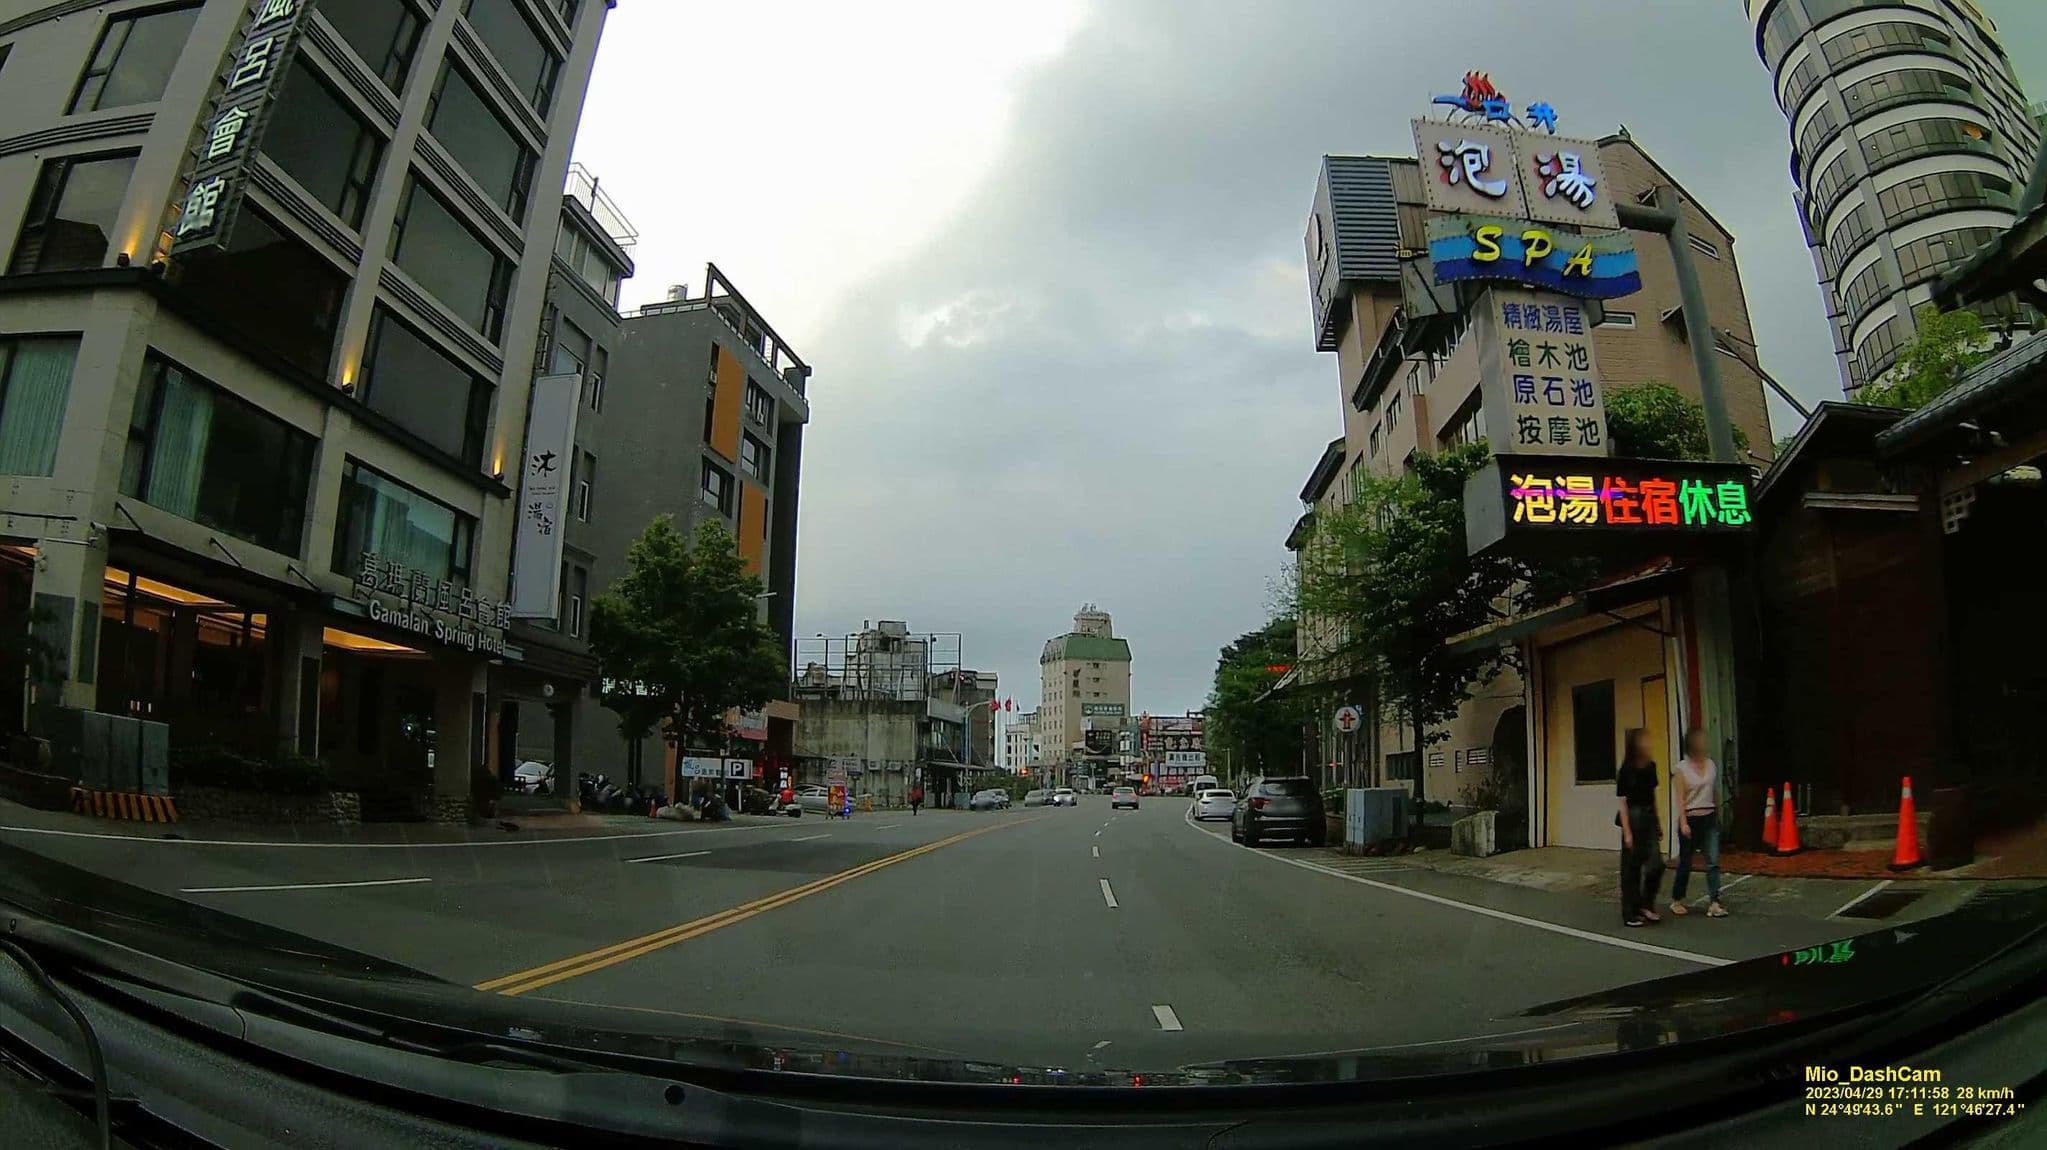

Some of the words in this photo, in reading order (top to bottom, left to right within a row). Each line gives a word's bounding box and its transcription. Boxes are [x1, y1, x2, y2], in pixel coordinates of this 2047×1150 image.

[1437, 138, 1596, 209] 泡湯
[1472, 224, 1594, 277] SPA
[1507, 338, 1590, 371] 檜木池
[1513, 375, 1595, 408] 原石池
[1517, 414, 1601, 447] 按摩池
[1509, 474, 1751, 526] 泡湯住宿休息
[369, 599, 429, 636] Gamalan
[435, 619, 476, 652] Spring
[478, 632, 506, 655] Hotel
[732, 762, 743, 776] P
